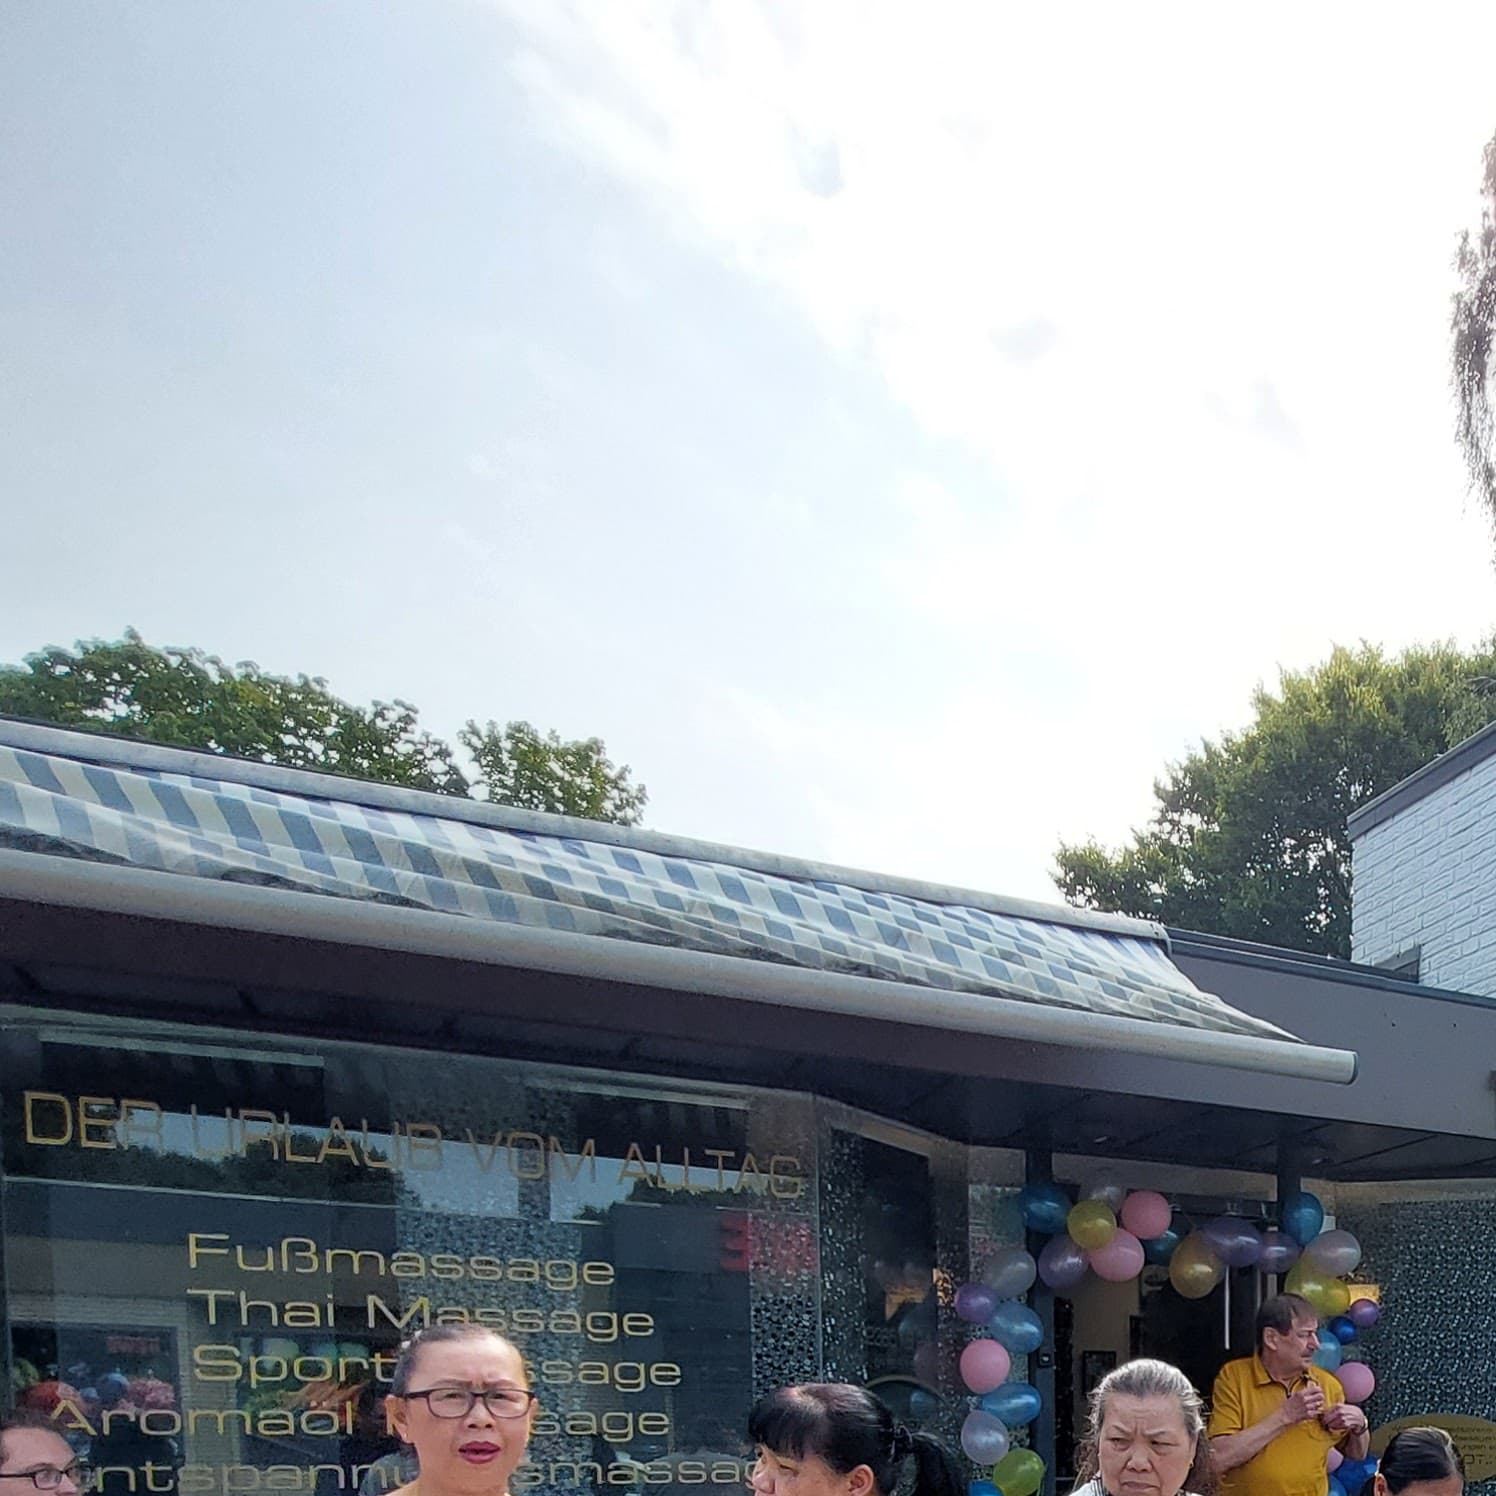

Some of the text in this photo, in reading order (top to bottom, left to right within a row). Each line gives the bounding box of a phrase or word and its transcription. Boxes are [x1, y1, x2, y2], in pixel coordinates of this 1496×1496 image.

[25, 1090, 802, 1199] DER URLAUB VOM ALLTAG
[188, 1232, 615, 1291] Fußmassage
[186, 1288, 655, 1343] Thai Massage
[193, 1344, 682, 1393] Sportsage
